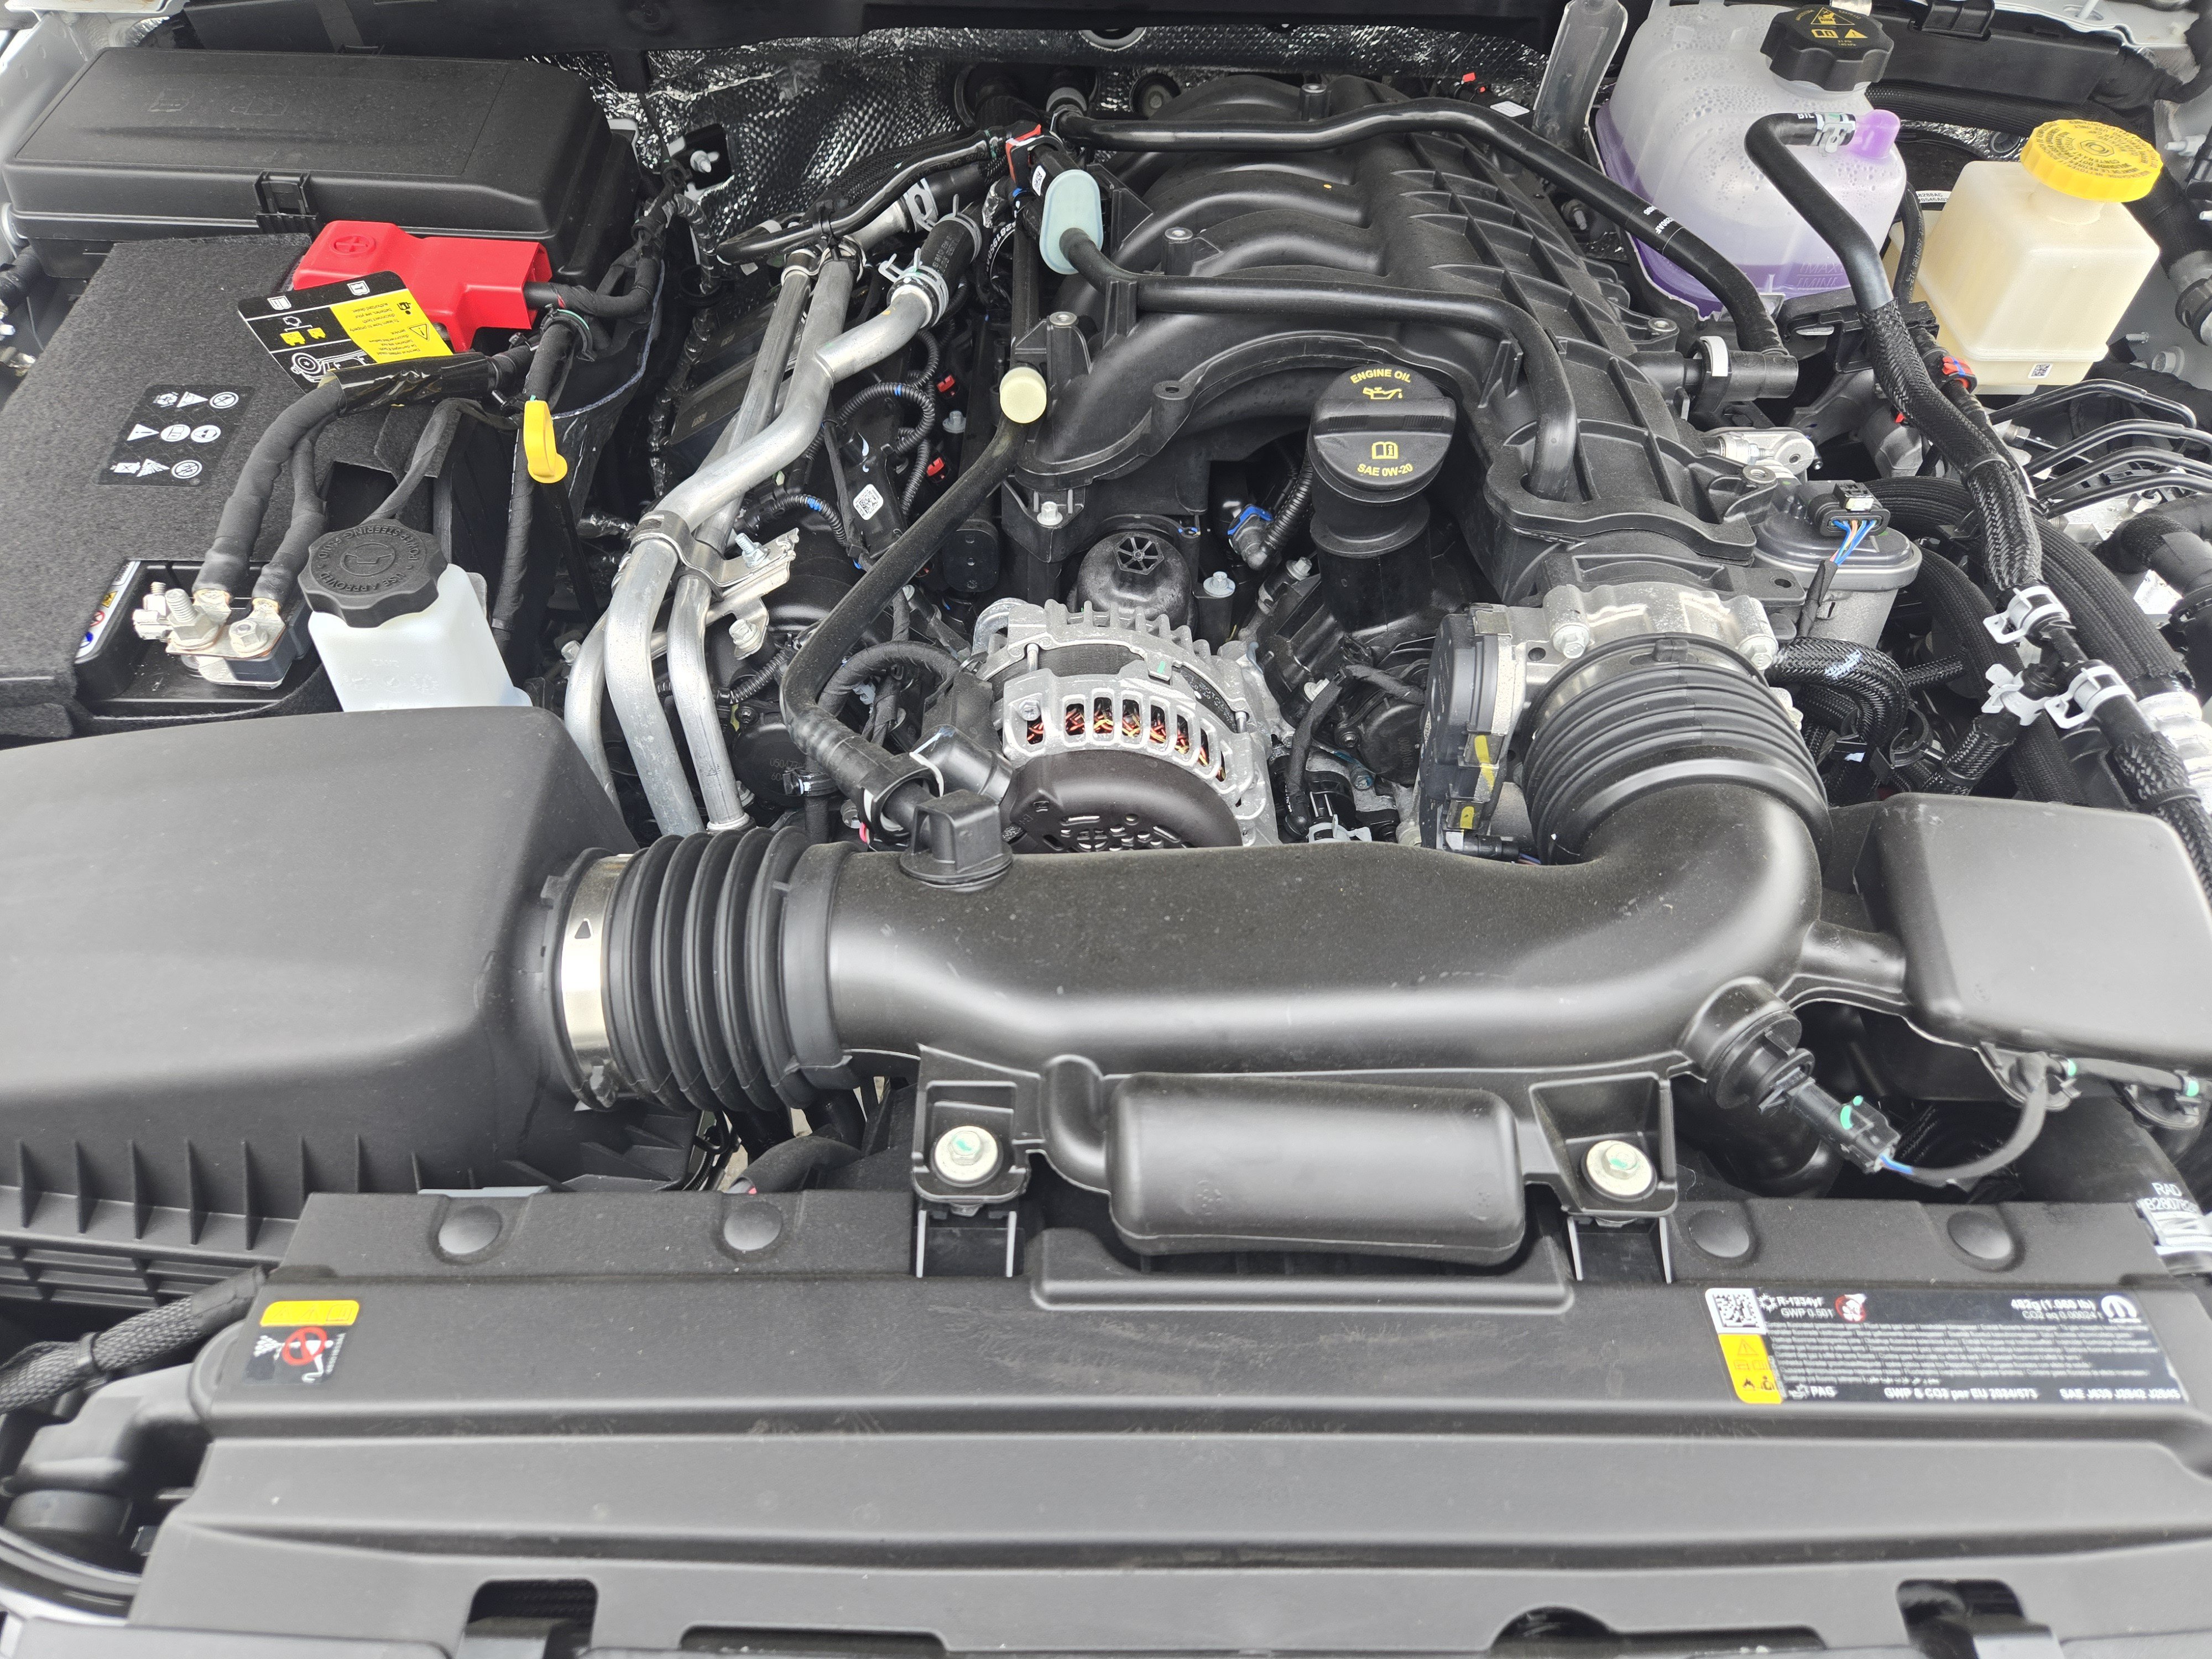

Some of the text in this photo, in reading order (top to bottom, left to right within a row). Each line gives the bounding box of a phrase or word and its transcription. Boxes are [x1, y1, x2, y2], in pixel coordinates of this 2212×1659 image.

[1350, 369, 1411, 384] ENGINE OIL
[1357, 463, 1413, 477] SAE 0W-20
[317, 525, 420, 561] POWER STEERING FLUID
[318, 572, 406, 592] USE APPROVED
[2152, 1182, 2182, 1197] RAD
[1777, 1296, 1823, 1307] R-1234yf
[1781, 1308, 1807, 1318] GWP
[2022, 1311, 2045, 1319] CO2
[1810, 1386, 1836, 1397] PAG
[1884, 1387, 1912, 1399] GWP
[1914, 1388, 1923, 1399] &
[1924, 1387, 1950, 1399] CO2
[1952, 1390, 1969, 1400] per
[1970, 1388, 1987, 1399] EU
[2059, 1389, 2085, 1399] SAE
